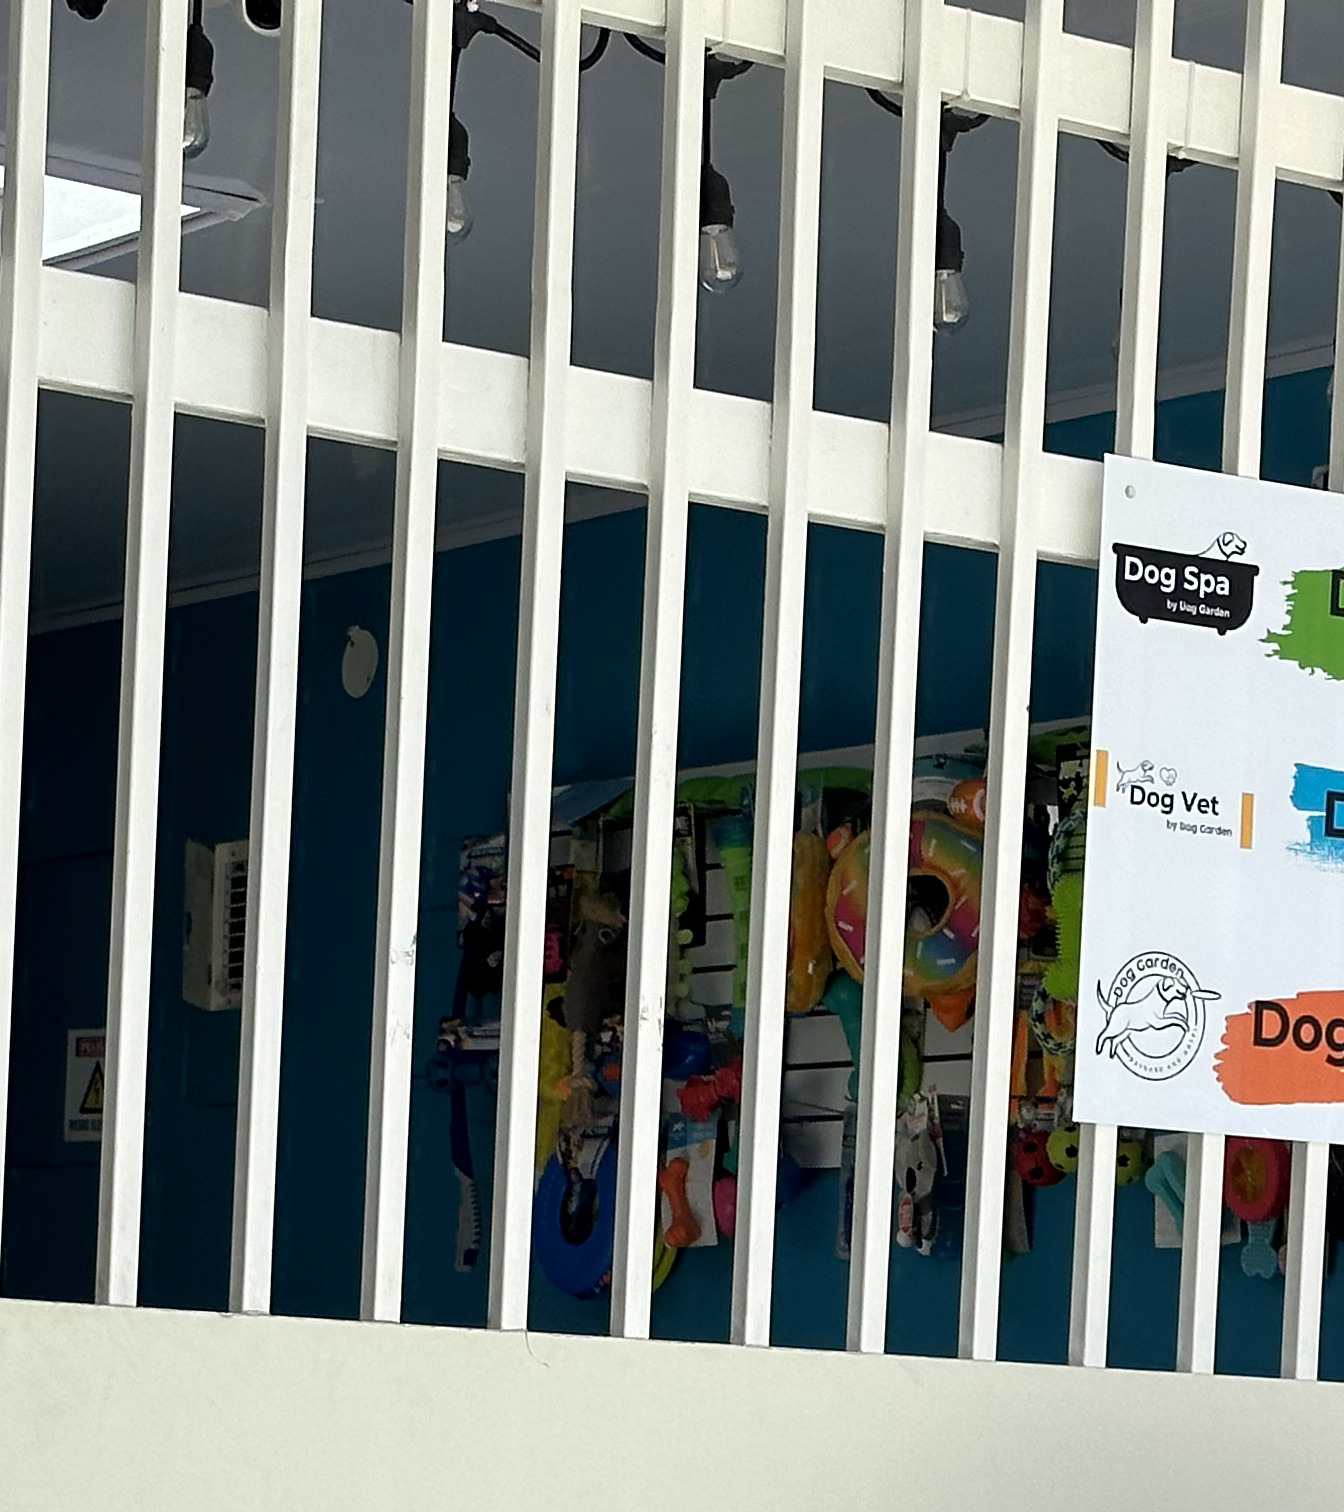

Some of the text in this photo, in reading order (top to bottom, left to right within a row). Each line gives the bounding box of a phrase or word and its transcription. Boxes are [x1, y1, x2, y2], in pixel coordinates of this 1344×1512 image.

[1124, 555, 1230, 598] Dog Spa
[1166, 599, 1177, 612] by
[1130, 785, 1219, 815] Dog Vet
[1166, 819, 1177, 832] by
[1114, 957, 1184, 998] Dog Garden
